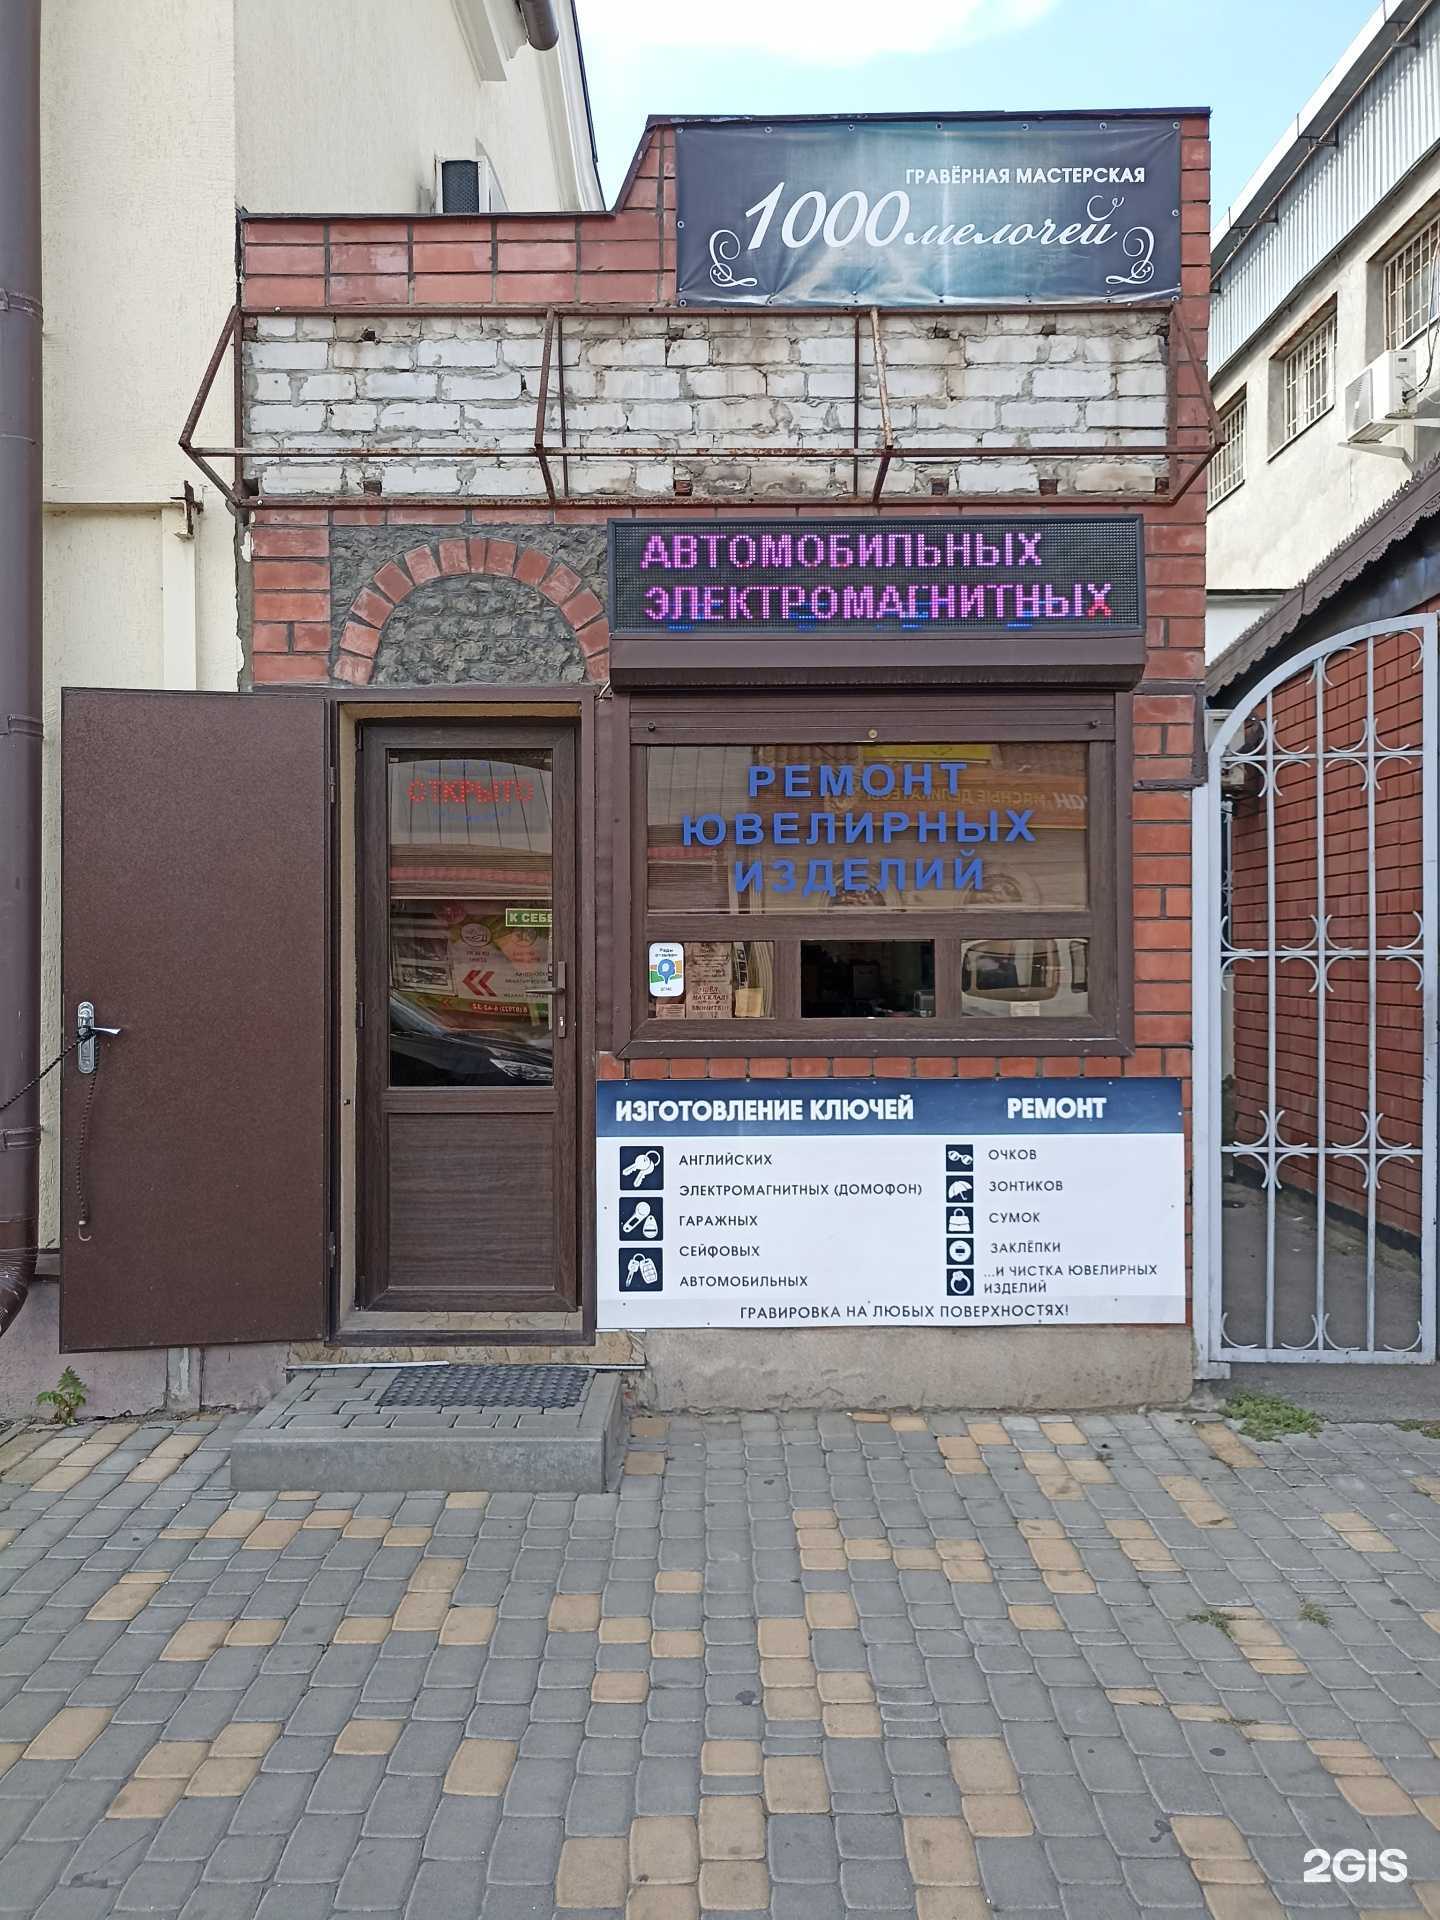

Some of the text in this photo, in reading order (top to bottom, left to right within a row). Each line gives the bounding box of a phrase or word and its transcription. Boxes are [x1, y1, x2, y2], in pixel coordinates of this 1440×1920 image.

[905, 165, 1146, 185] ГРАВЁРНАЯ МАСТЕРСКАЯ
[745, 181, 1125, 251] 1000 мелочей
[640, 532, 1043, 569] АВТОМОБИЛЬНЫХ
[644, 582, 1113, 620] ЭЛЕКТРОМАГНИТНЫХ
[747, 763, 968, 798] РЕМОНТ
[407, 778, 534, 803] ОТКРЫТО
[681, 809, 1036, 848] ЮВЕЛИРНЫХ
[733, 849, 986, 896] ИЗДЕЛИЙ
[509, 912, 518, 922] К
[615, 1093, 914, 1122] ИЗГОТОВЛЕНИЕ КЛЮЧЕЙ
[1007, 1097, 1107, 1120] РЕМОНТ
[678, 1152, 773, 1167] АНГЛИЙСКИХ
[988, 1149, 1037, 1161] ОЧКОВ
[679, 1182, 923, 1198] ЭЛЕКТРОМАГНИТНЫХ (ДОМОФОН)
[988, 1180, 1064, 1193] ЗОНТИКОВ
[679, 1214, 759, 1228] ГАРАЖНЫХ
[988, 1212, 1041, 1224] СУМОК
[679, 1242, 760, 1257] СЕЙФОВЫХ
[990, 1240, 1061, 1254] ЗАКЛЁПКИ
[1008, 1265, 1064, 1277] ЧИСТКА
[1068, 1264, 1158, 1277] ЮВЕЛИРНЫХ
[679, 1275, 808, 1288] АВТОМОБИЛЬНЫХ
[984, 1279, 1047, 1295] ИЗДЕЛИЙ
[740, 1303, 1069, 1319] ГРАВИРОВКА НА ЛЮБЫХ ПОВЕРХНОСТЯХ!
